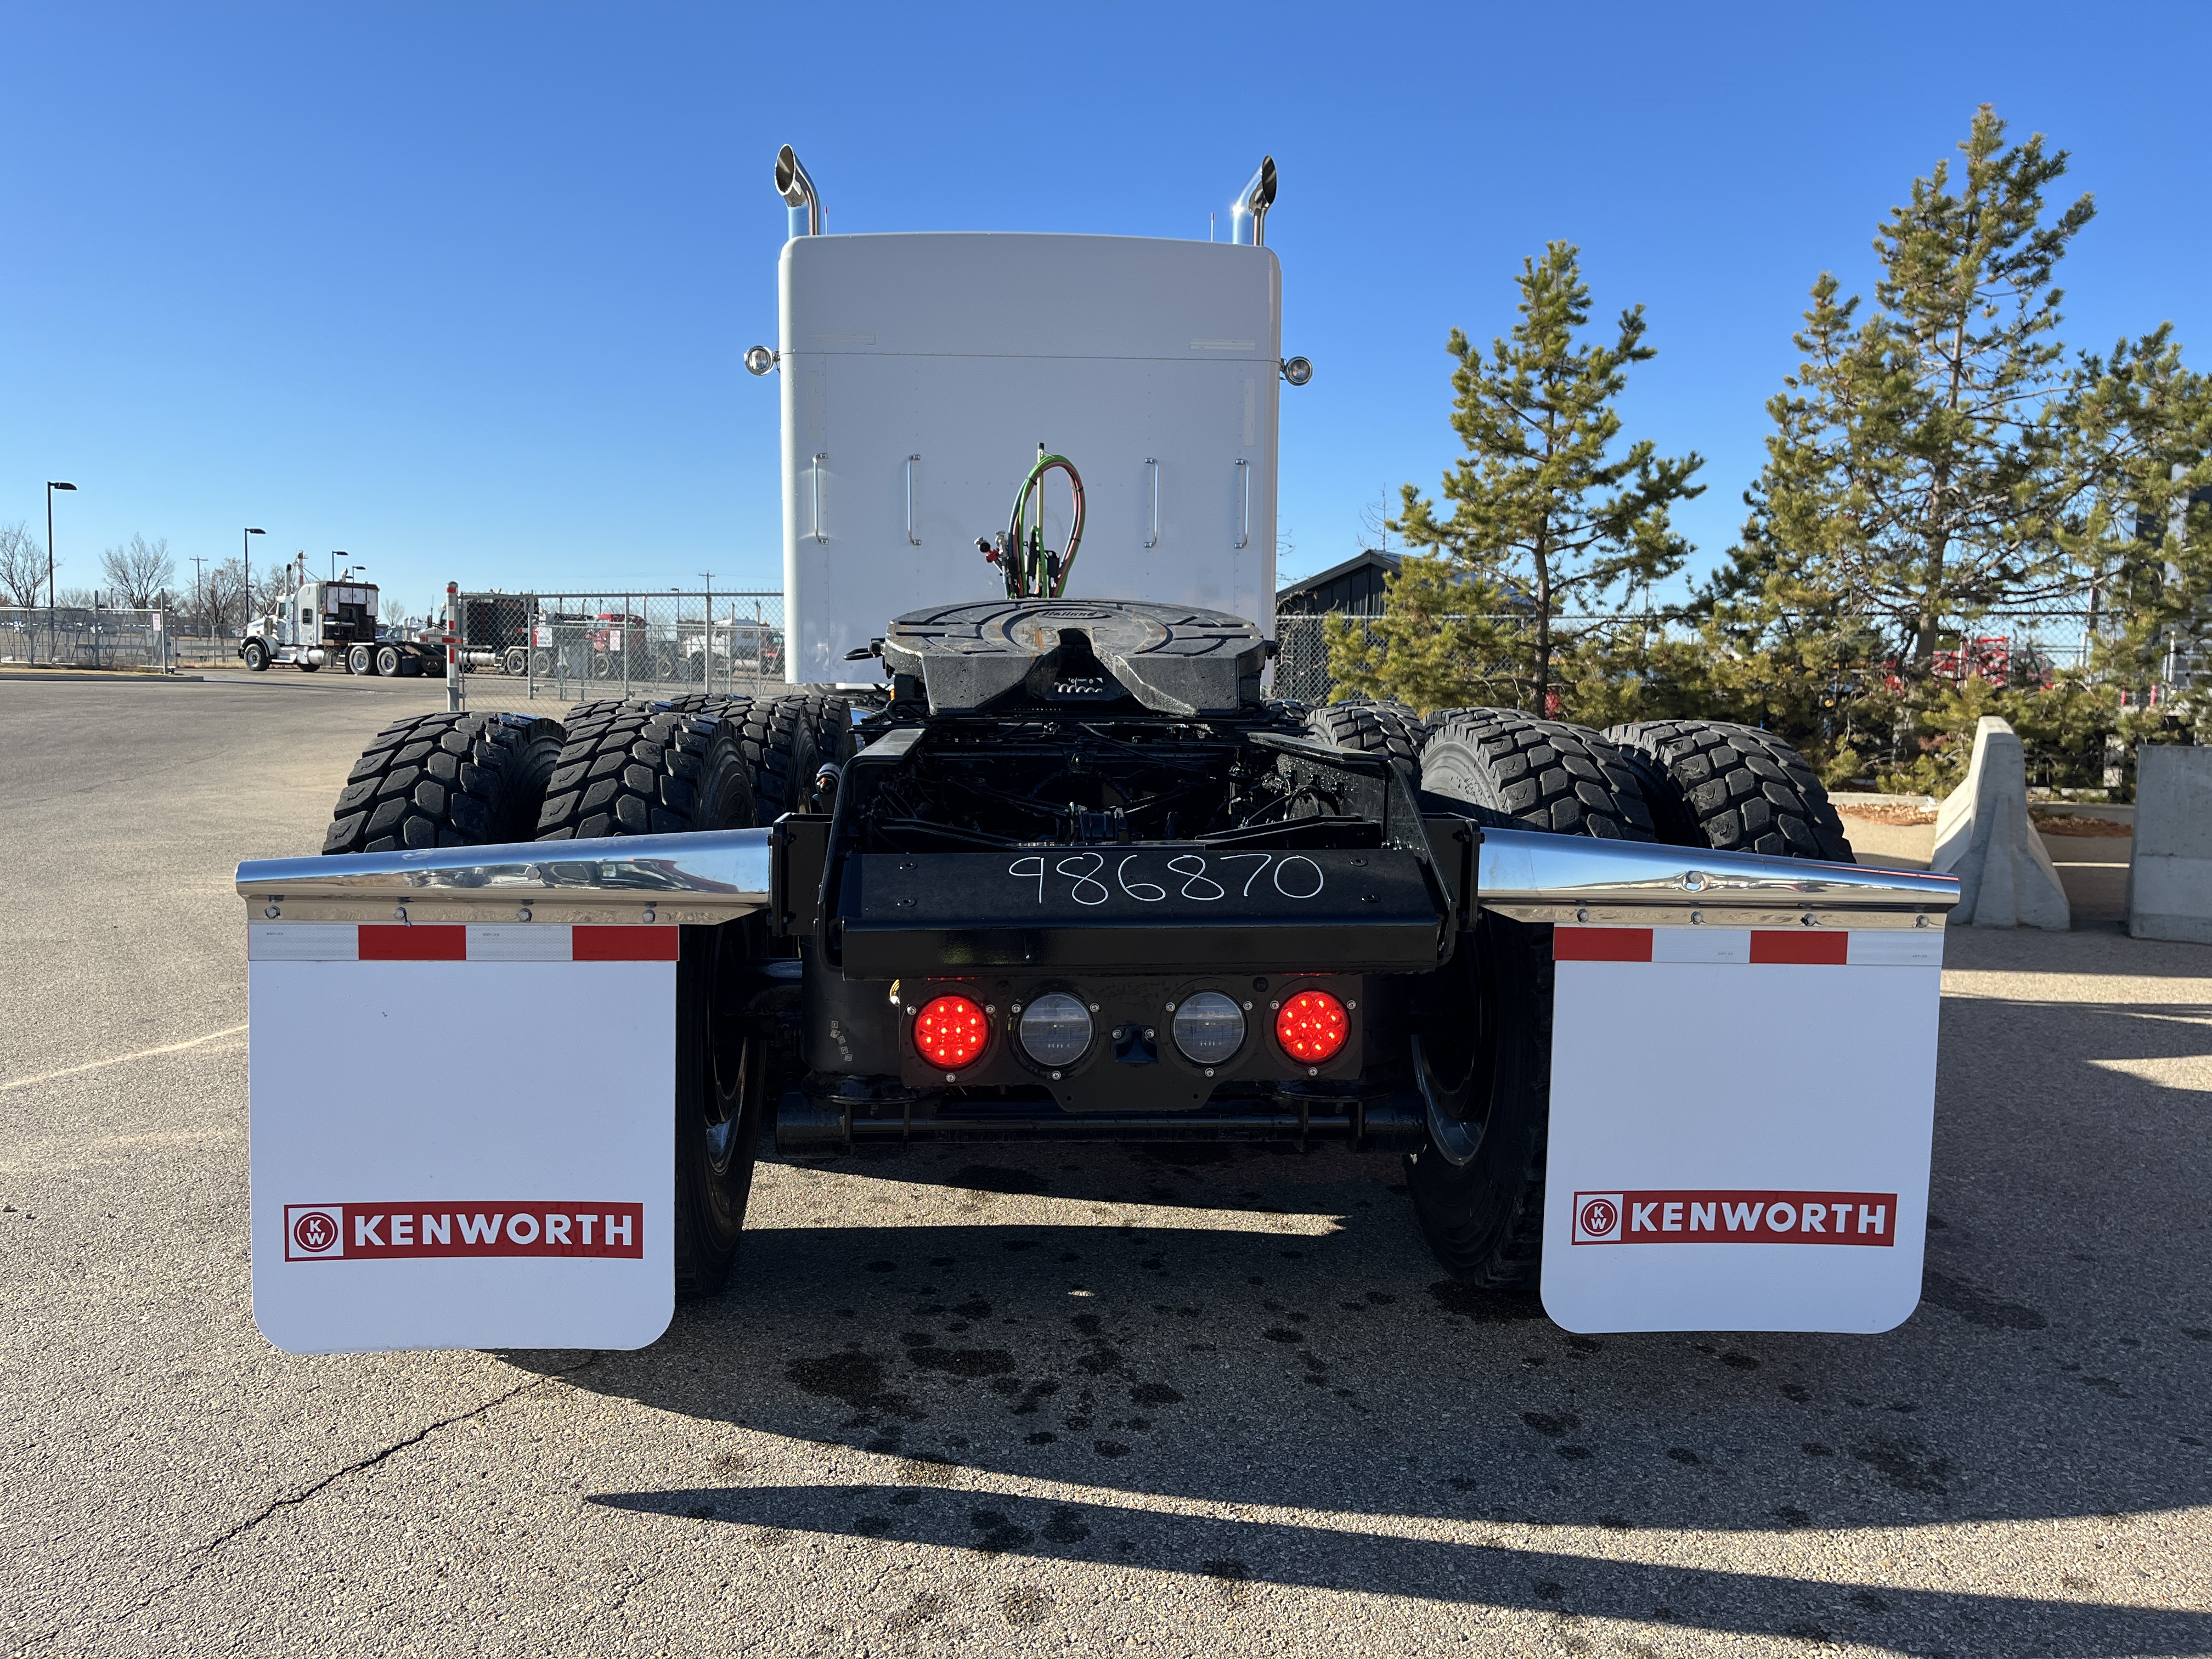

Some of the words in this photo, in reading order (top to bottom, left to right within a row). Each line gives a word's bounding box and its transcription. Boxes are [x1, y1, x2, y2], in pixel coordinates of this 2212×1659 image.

[1008, 851, 1324, 906] 986870
[354, 1213, 632, 1246] KENWORTH
[1631, 1202, 1886, 1234] KENWORTH
